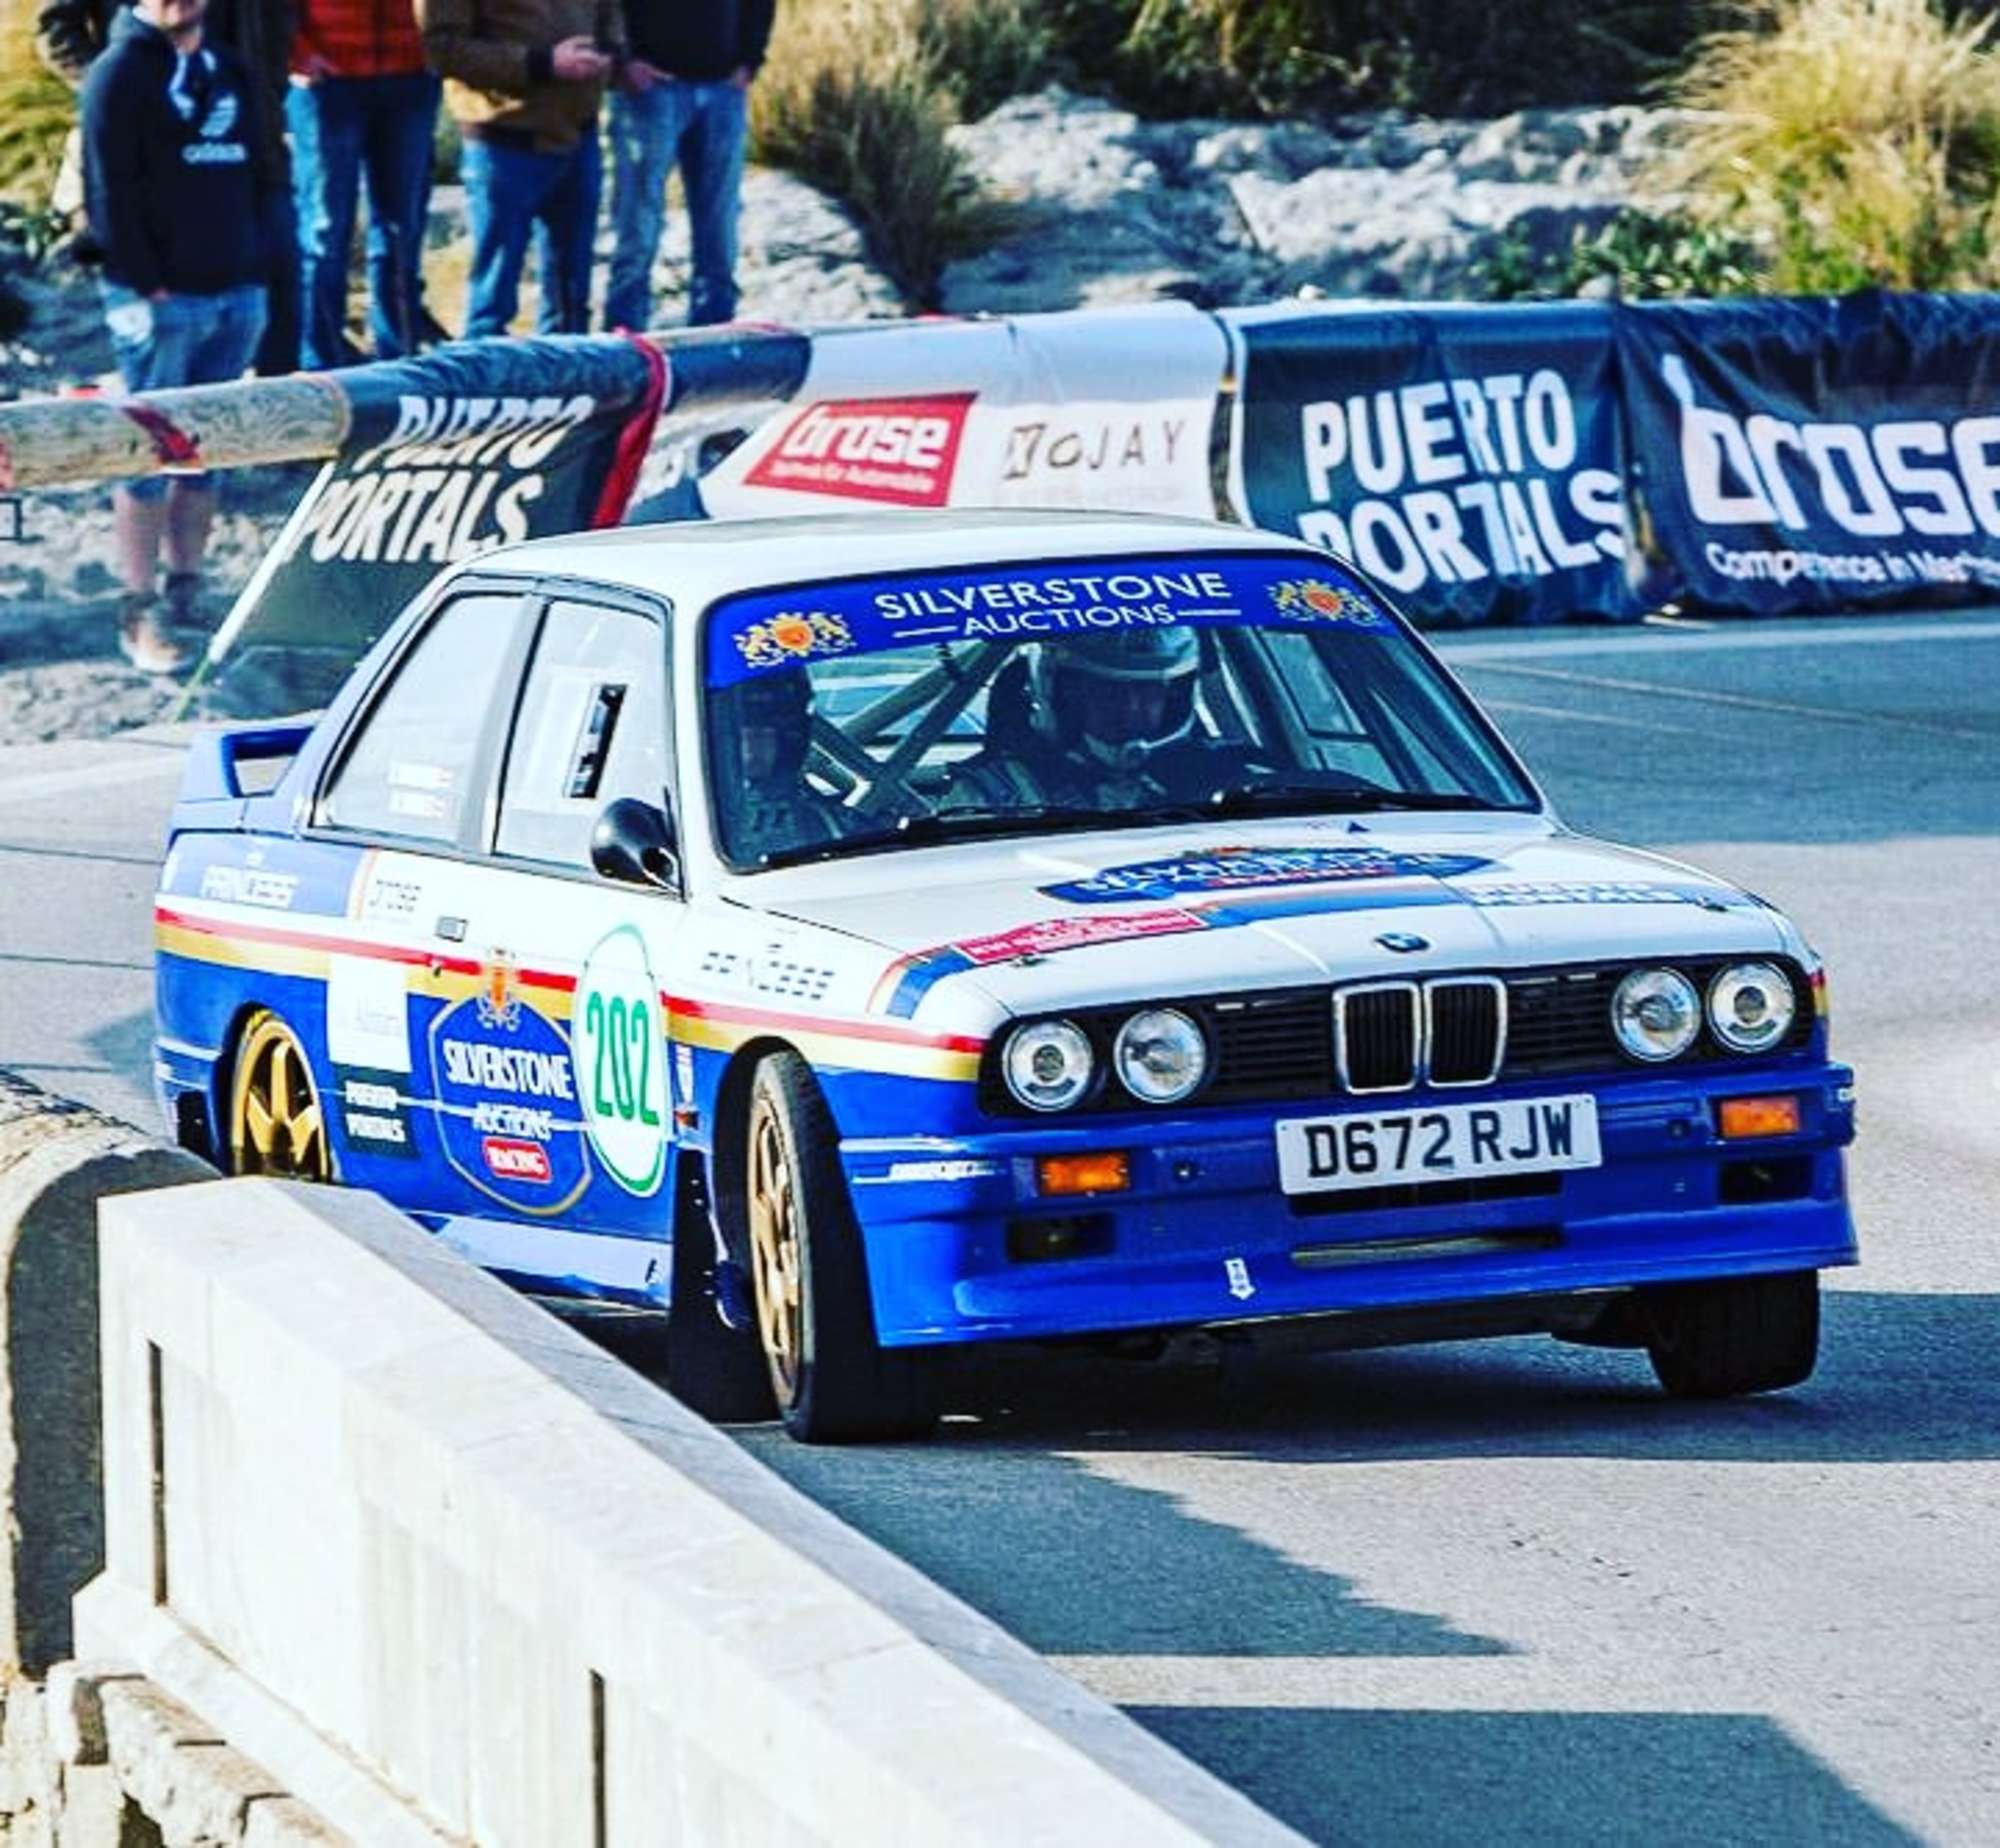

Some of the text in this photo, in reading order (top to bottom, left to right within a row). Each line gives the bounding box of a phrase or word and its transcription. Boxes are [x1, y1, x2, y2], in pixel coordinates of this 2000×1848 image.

[351, 395, 597, 471] PUERTO
[780, 405, 950, 468] brose
[1302, 369, 1577, 503] PUERTO
[304, 472, 544, 563] PORTALS
[1298, 469, 1627, 594] PORTALS
[875, 573, 1232, 620] SILVERSTONE
[964, 604, 1176, 636] AUCTIONS
[443, 1038, 574, 1100] SILVERSTONE
[586, 990, 660, 1126] 202
[1304, 1102, 1573, 1178] D672 RJW
